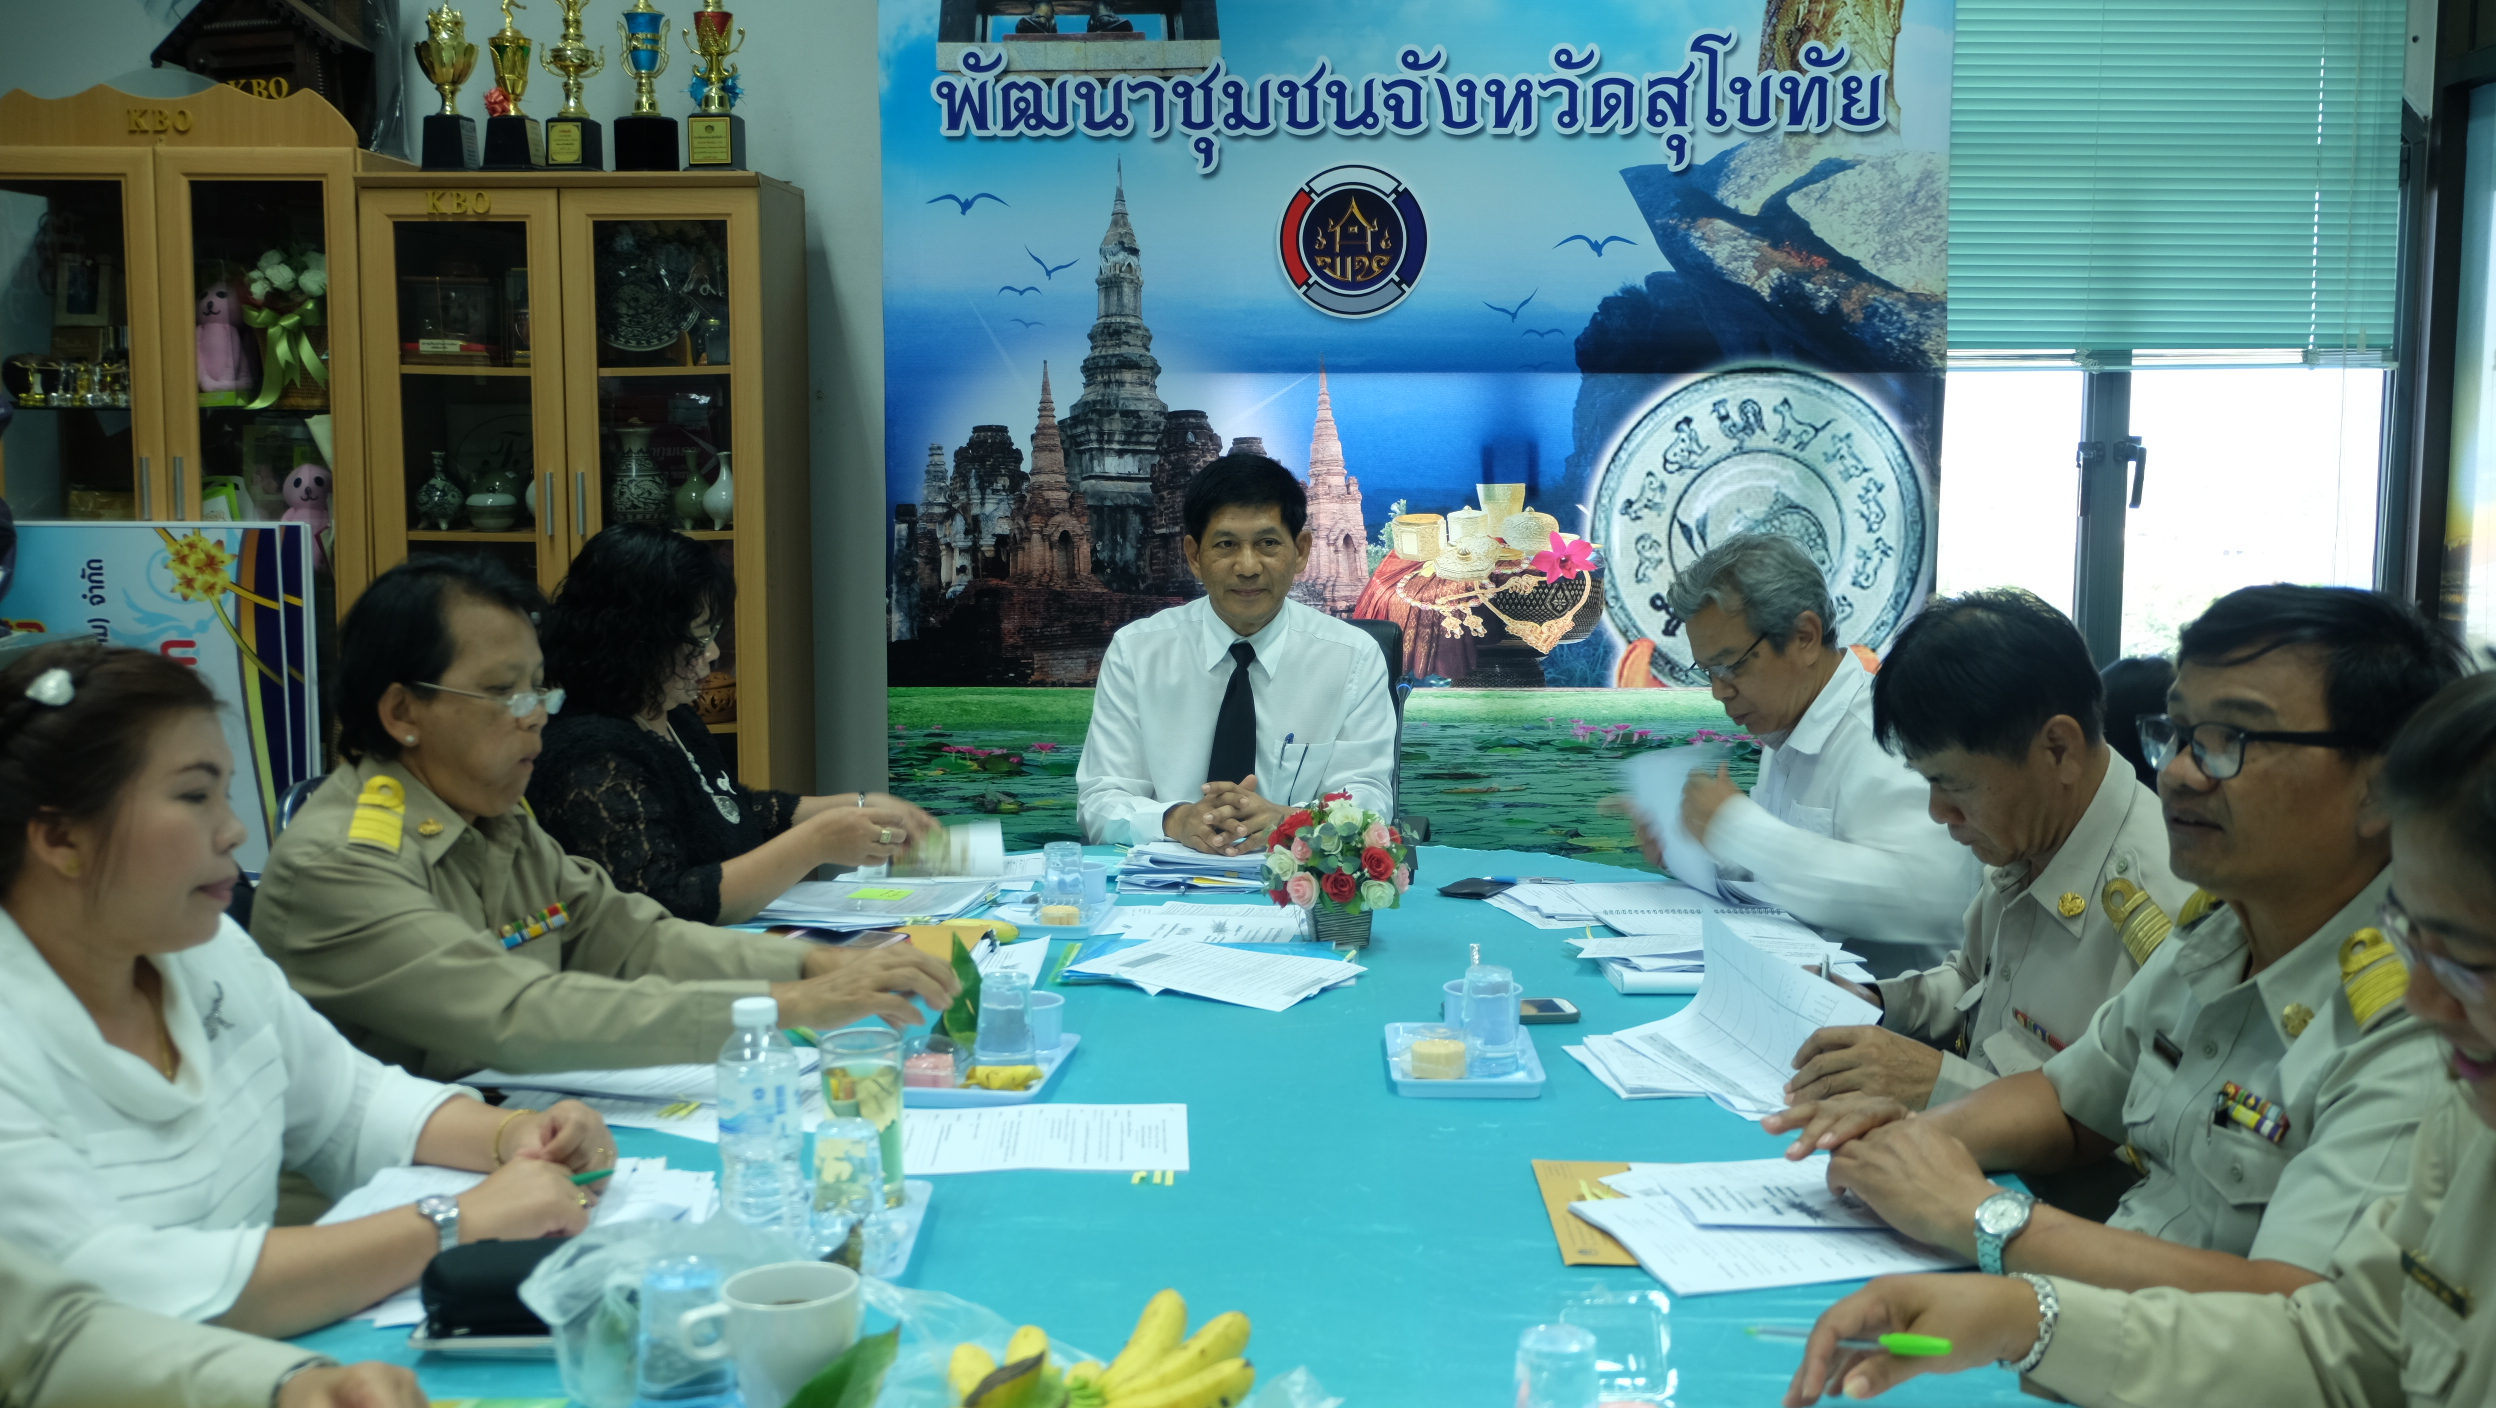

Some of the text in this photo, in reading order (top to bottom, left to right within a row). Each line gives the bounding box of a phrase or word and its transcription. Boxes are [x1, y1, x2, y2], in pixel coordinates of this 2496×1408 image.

[936, 32, 1882, 169] พัฒนาชุมชนจังหวัดสุโขทัย
[127, 109, 193, 134] KBO
[426, 190, 491, 214] KBO
[80, 559, 106, 606] จำกัด
